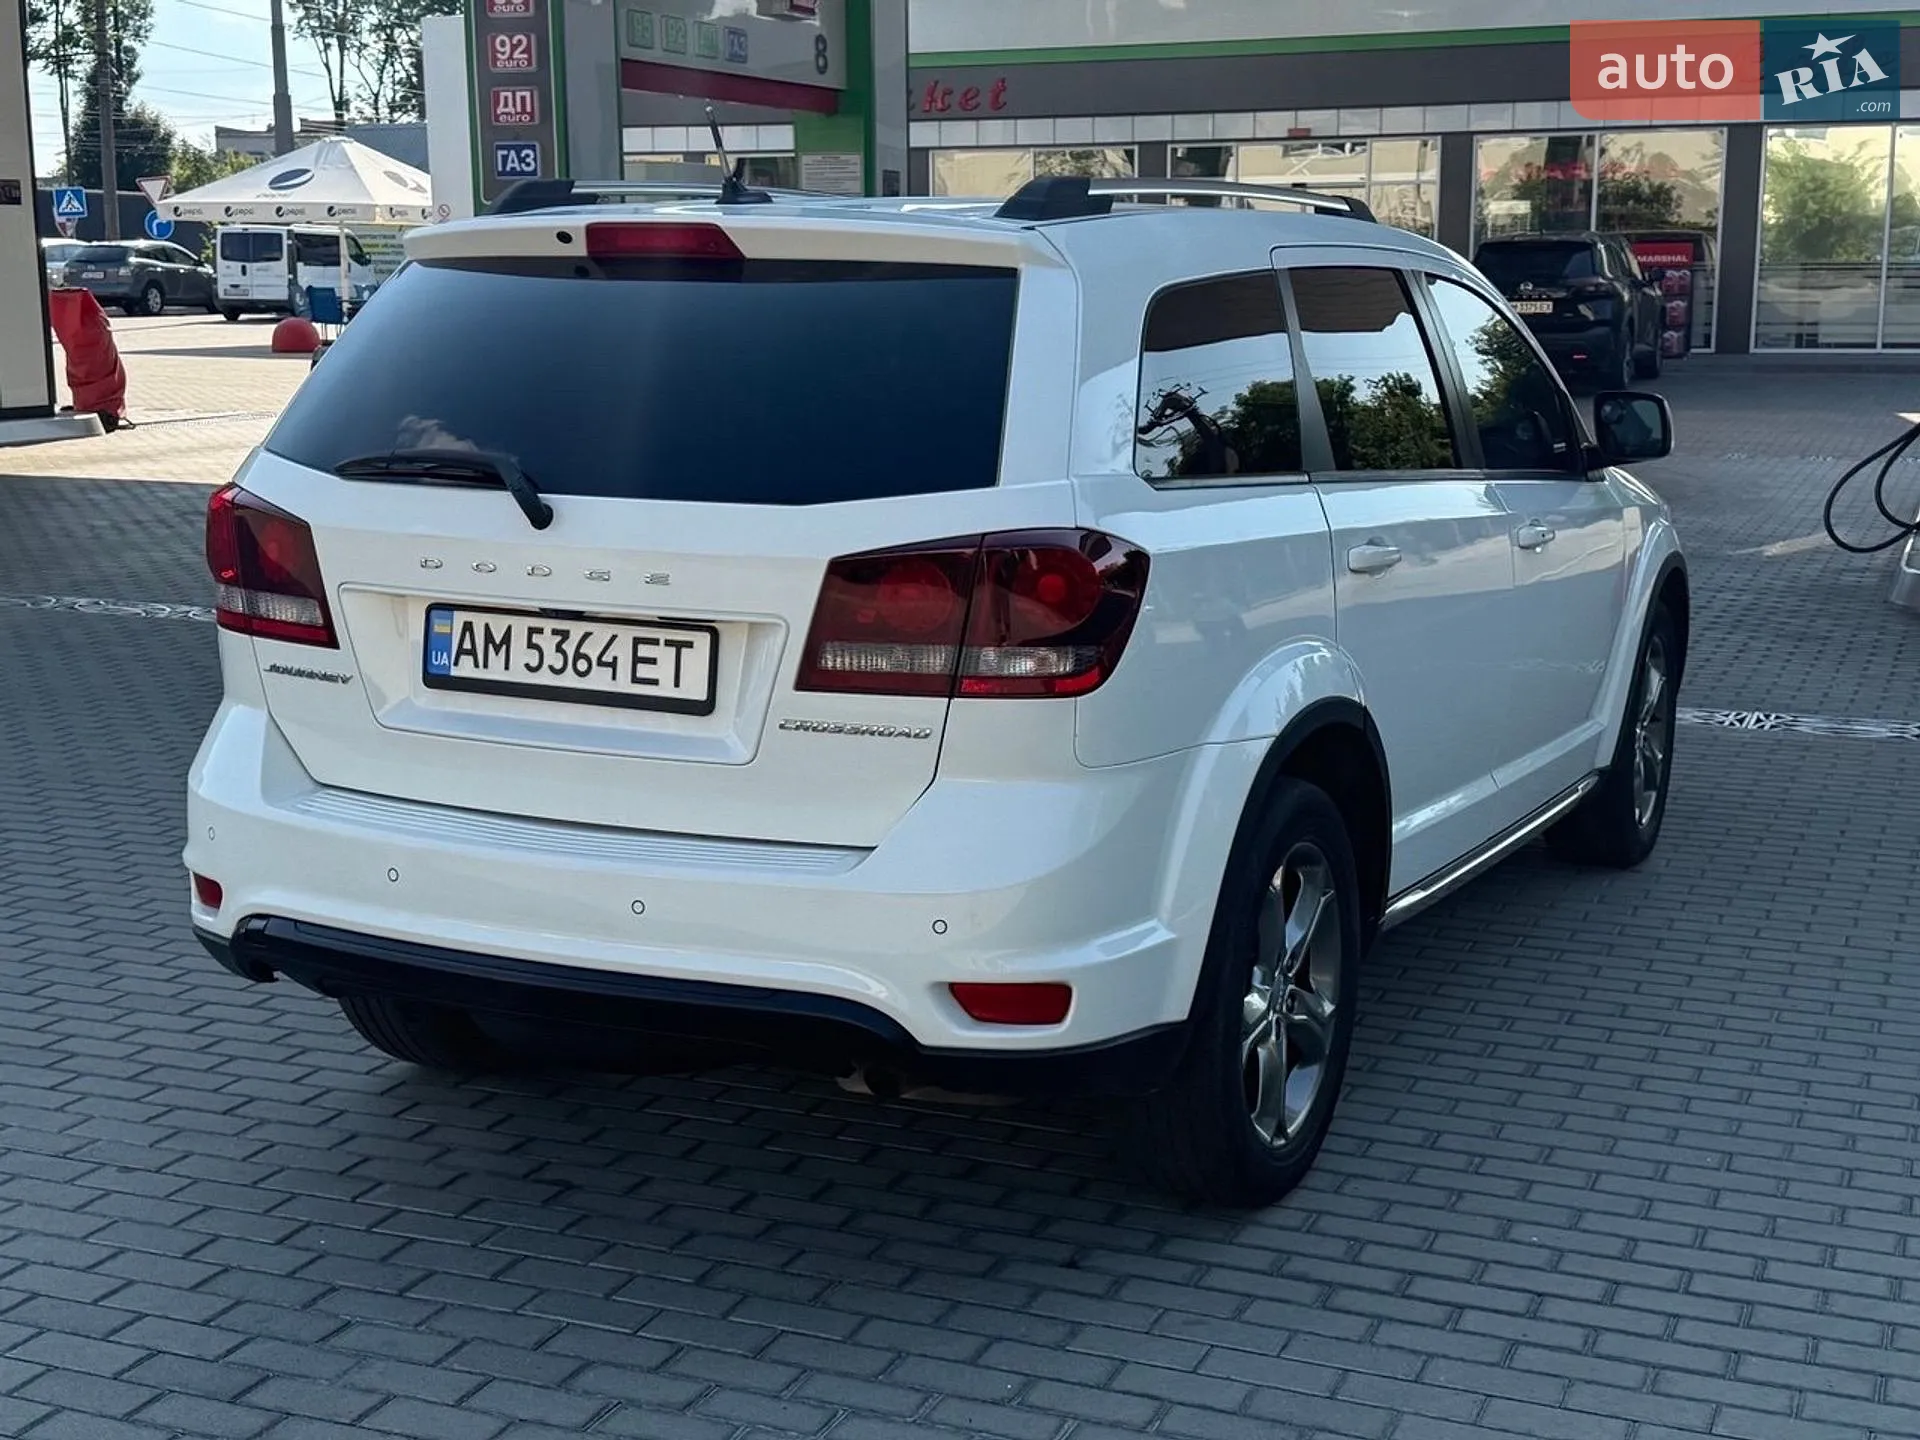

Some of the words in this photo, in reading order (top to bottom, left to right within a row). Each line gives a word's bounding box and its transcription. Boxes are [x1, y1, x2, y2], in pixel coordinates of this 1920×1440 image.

[494, 4, 525, 12] euro
[495, 34, 528, 60] 92
[815, 34, 828, 75] 8
[497, 60, 528, 68] euro
[496, 91, 532, 114] ДП
[499, 113, 530, 122] euro
[496, 149, 536, 172] ГАЗ
[1637, 254, 1689, 263] MARSHAL
[420, 557, 671, 585] DODGE
[432, 651, 450, 666] UA
[453, 620, 513, 671] AM
[524, 626, 619, 681] 5364
[631, 636, 694, 689] ET
[263, 663, 353, 684] JOURNEY
[779, 718, 932, 739] CROSSROAD
